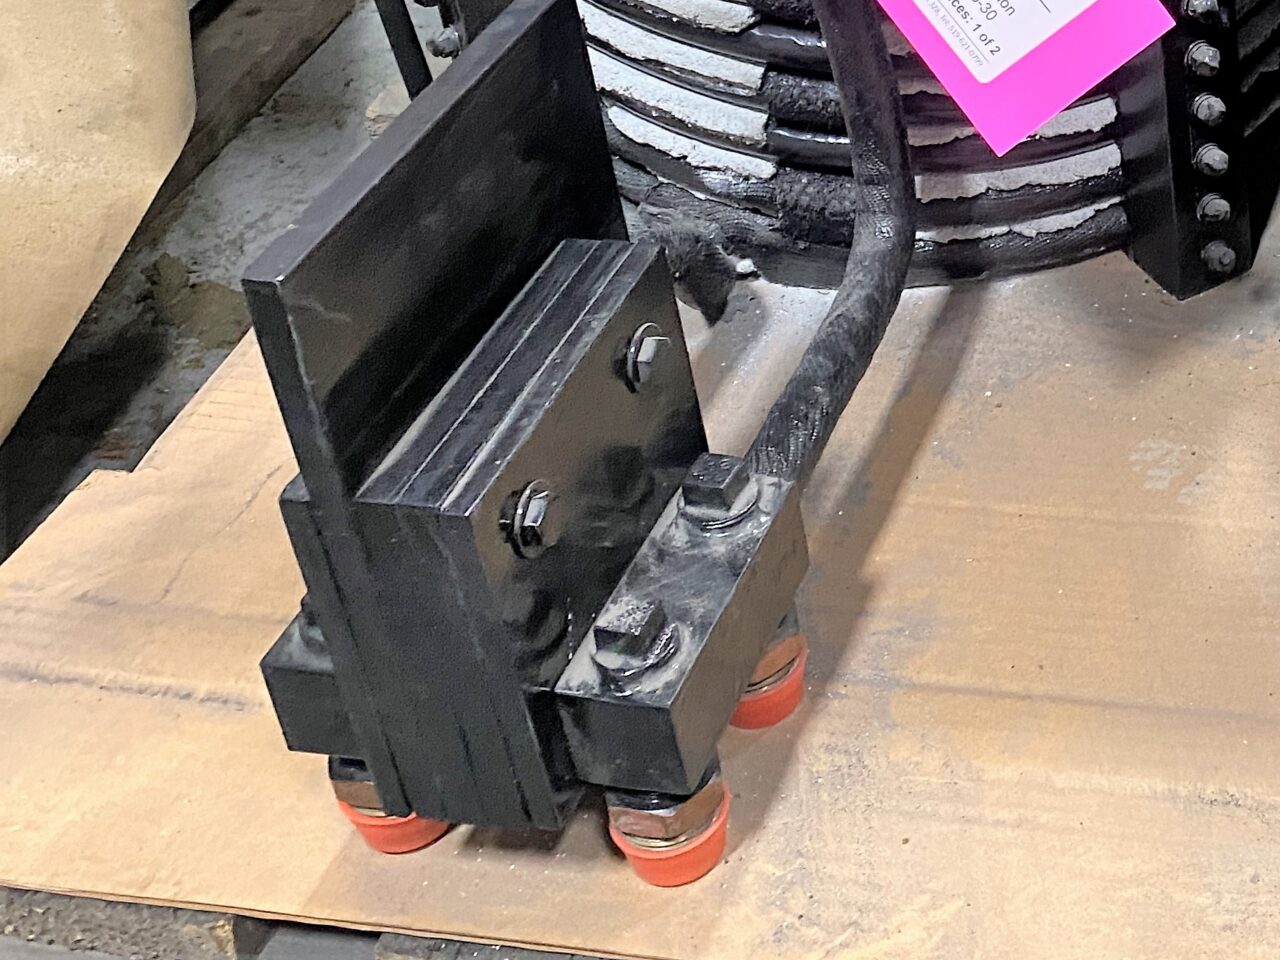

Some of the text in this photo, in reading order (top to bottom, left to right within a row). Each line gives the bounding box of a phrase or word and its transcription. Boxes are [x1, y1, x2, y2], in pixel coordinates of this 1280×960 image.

[969, 21, 982, 33] 1
[977, 29, 995, 48] of
[988, 43, 1002, 57] 2
